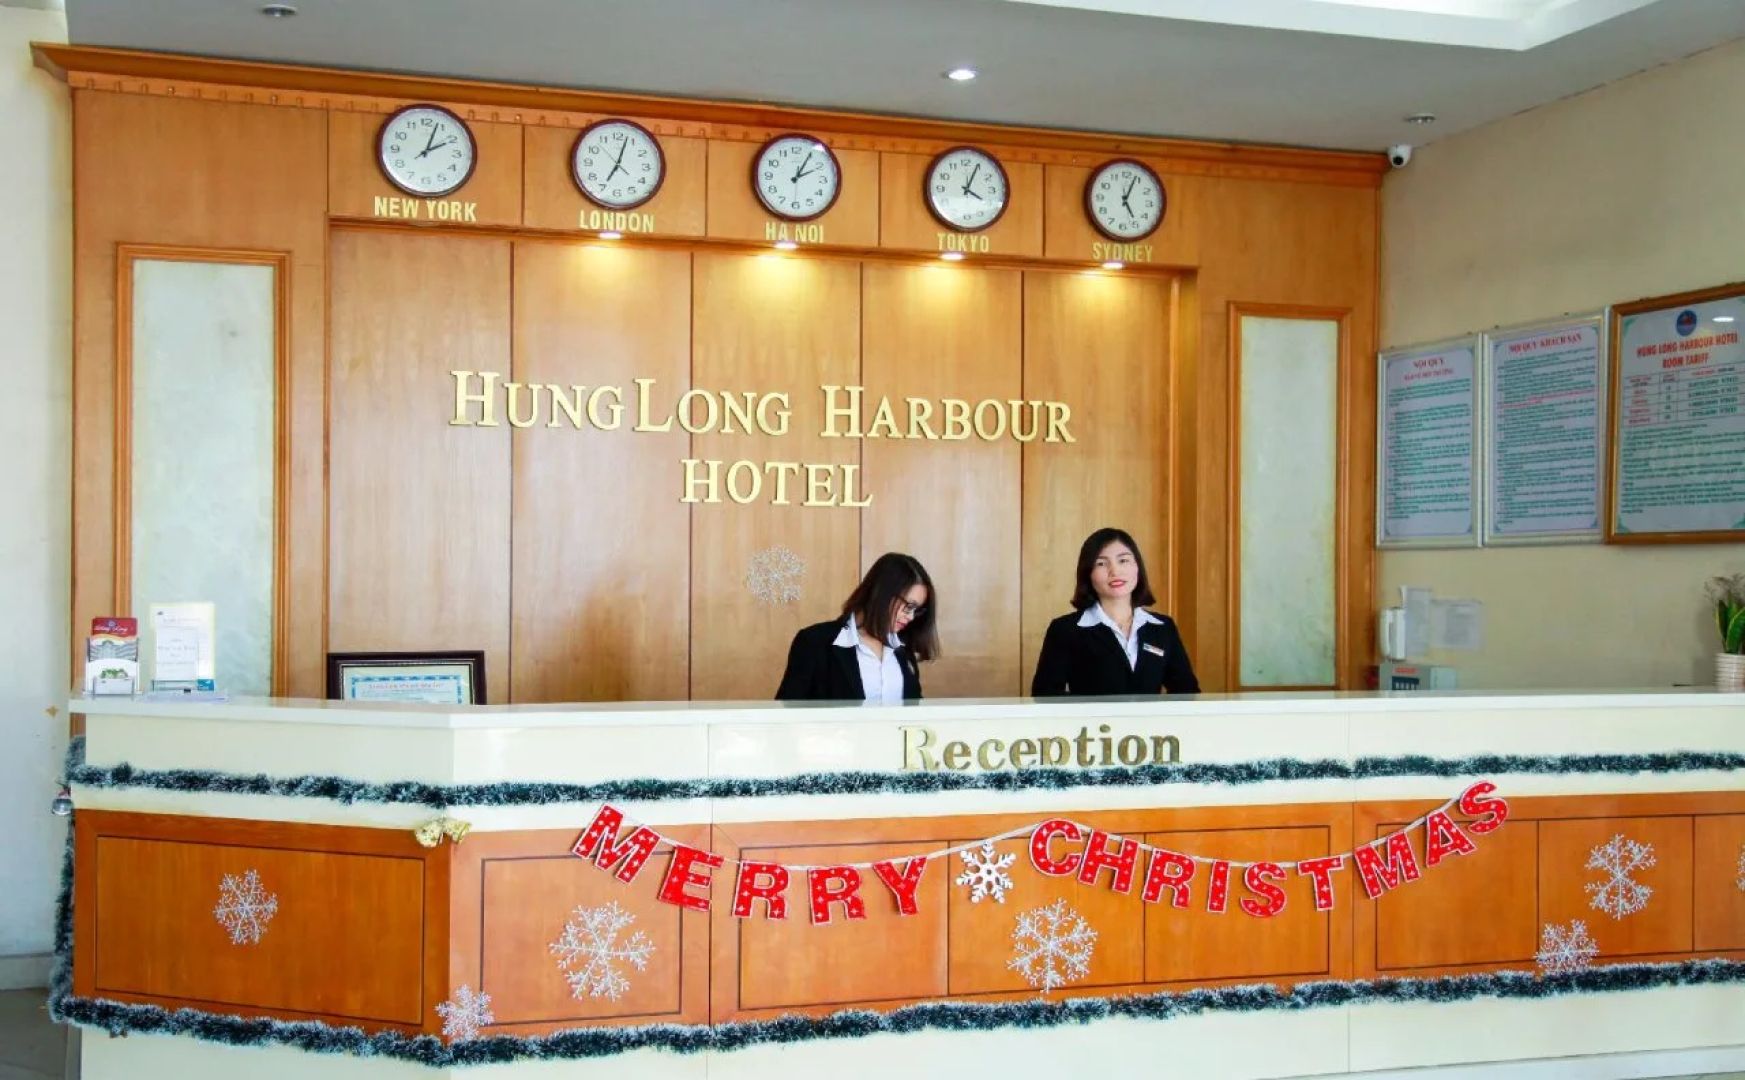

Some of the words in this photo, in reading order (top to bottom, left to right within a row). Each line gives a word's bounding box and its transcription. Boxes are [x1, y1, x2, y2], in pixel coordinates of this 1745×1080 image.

[406, 122, 416, 130] 11
[421, 118, 433, 127] 12
[395, 131, 407, 141] 10
[446, 135, 458, 144] 2
[612, 132, 624, 141] 12
[390, 145, 400, 153] 9
[589, 146, 600, 155] 10
[452, 150, 462, 159] 3
[638, 150, 647, 158] 2
[583, 159, 593, 167] 9
[769, 160, 779, 168] 10
[815, 162, 824, 170] 2
[961, 159, 971, 167] 12
[447, 164, 456, 172] 4
[642, 164, 651, 172] 3
[588, 173, 597, 181] 8
[765, 172, 773, 181] 9
[819, 176, 828, 184] 3
[940, 173, 950, 181] 10
[599, 184, 607, 192] 7
[769, 186, 777, 194] 8
[936, 185, 945, 193] 9
[988, 186, 996, 194] 3
[1143, 187, 1151, 195] 2
[815, 189, 823, 197] 4
[778, 196, 786, 204] 7
[1096, 194, 1105, 202] 9
[1145, 200, 1153, 208] 3
[374, 196, 418, 219] NEW
[426, 199, 477, 222] YORK
[1099, 207, 1107, 215] 8
[578, 209, 654, 233] LONDON
[1132, 221, 1139, 229] 5
[765, 221, 788, 241] HA
[795, 223, 824, 244] NOI
[938, 232, 989, 253] TOKYO
[1092, 241, 1153, 262] SYDNEY
[820, 385, 1076, 442] HARBOUR
[679, 458, 873, 507] HOTEL
[898, 724, 1183, 771] Reception
[571, 803, 929, 925] MERRY
[1028, 781, 1511, 918] CHRISTMAS
